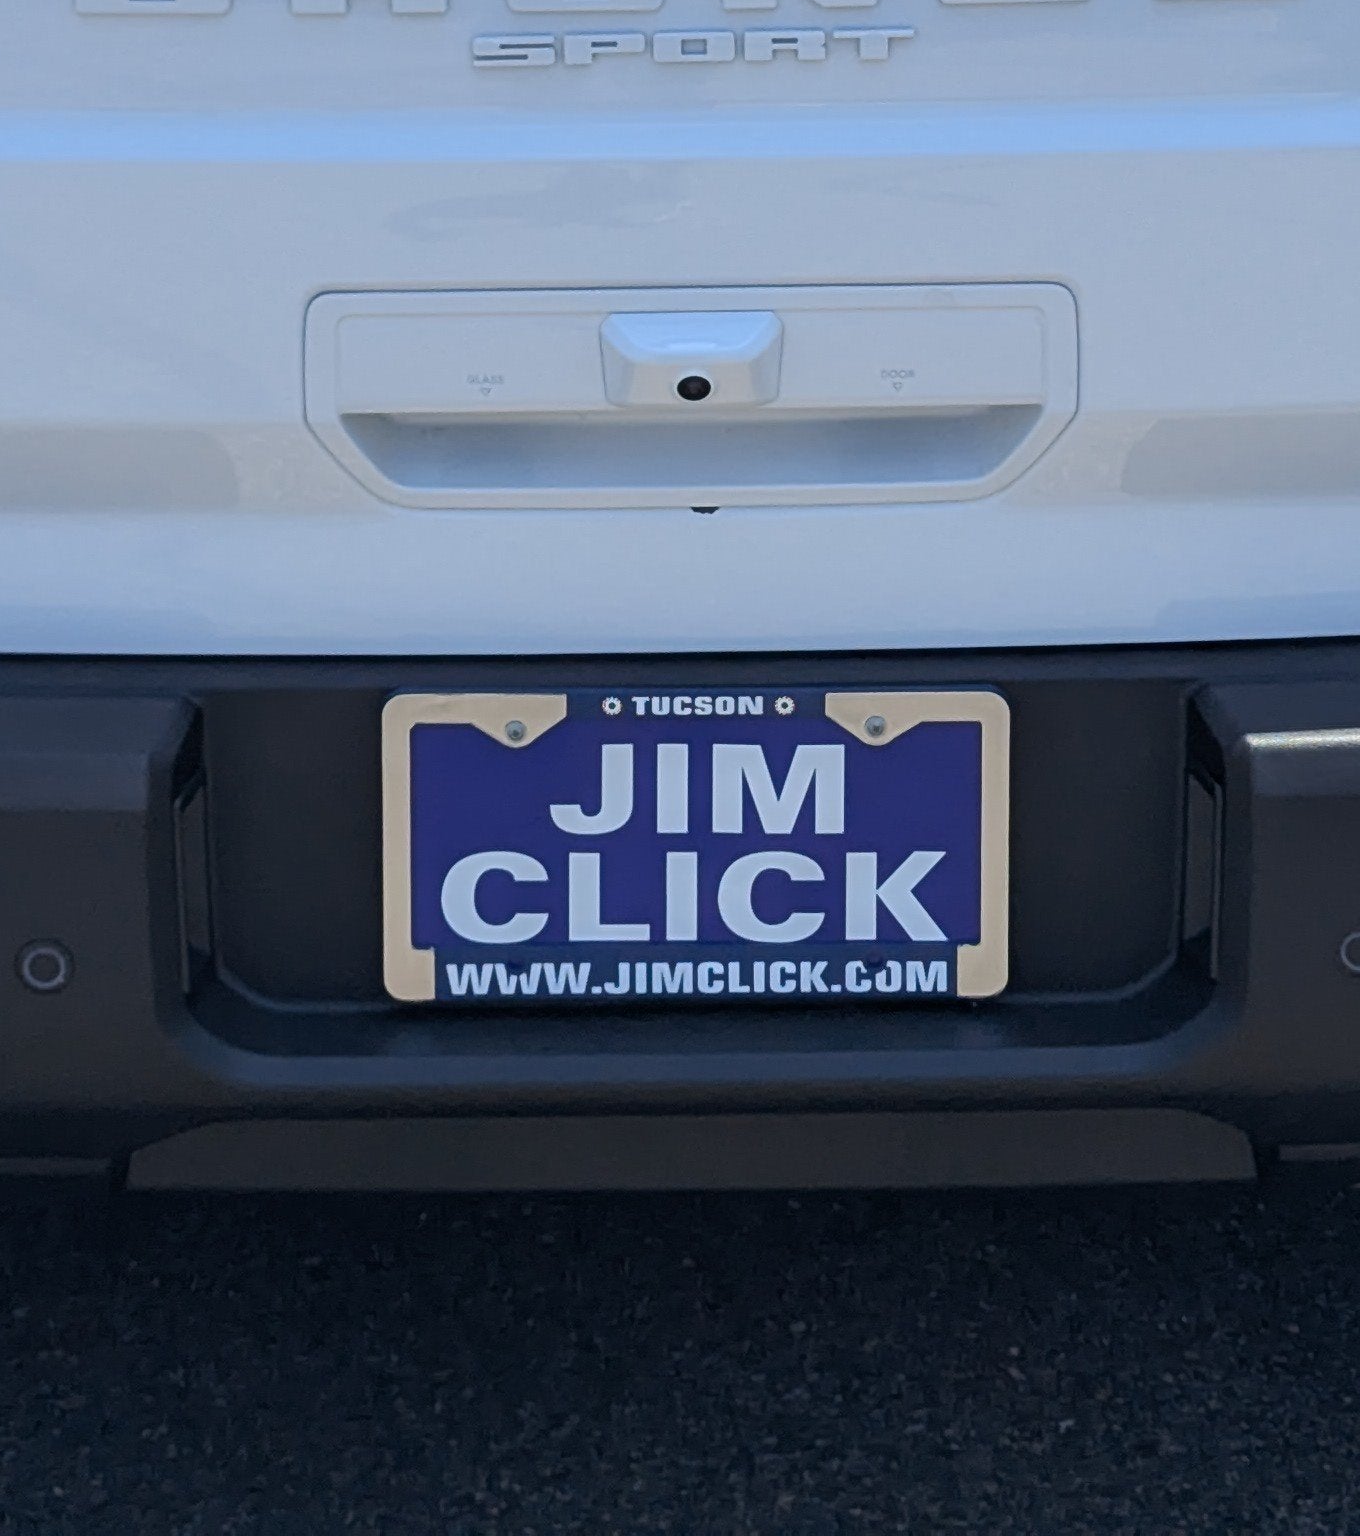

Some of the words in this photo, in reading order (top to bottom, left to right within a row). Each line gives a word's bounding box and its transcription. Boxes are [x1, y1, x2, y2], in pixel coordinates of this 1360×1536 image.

[472, 28, 915, 67] SPORT
[631, 695, 765, 716] TUCSON
[549, 743, 845, 835] JIM
[440, 850, 948, 944] CLICK
[445, 960, 948, 996] WWW.JIMCLICK.COM
